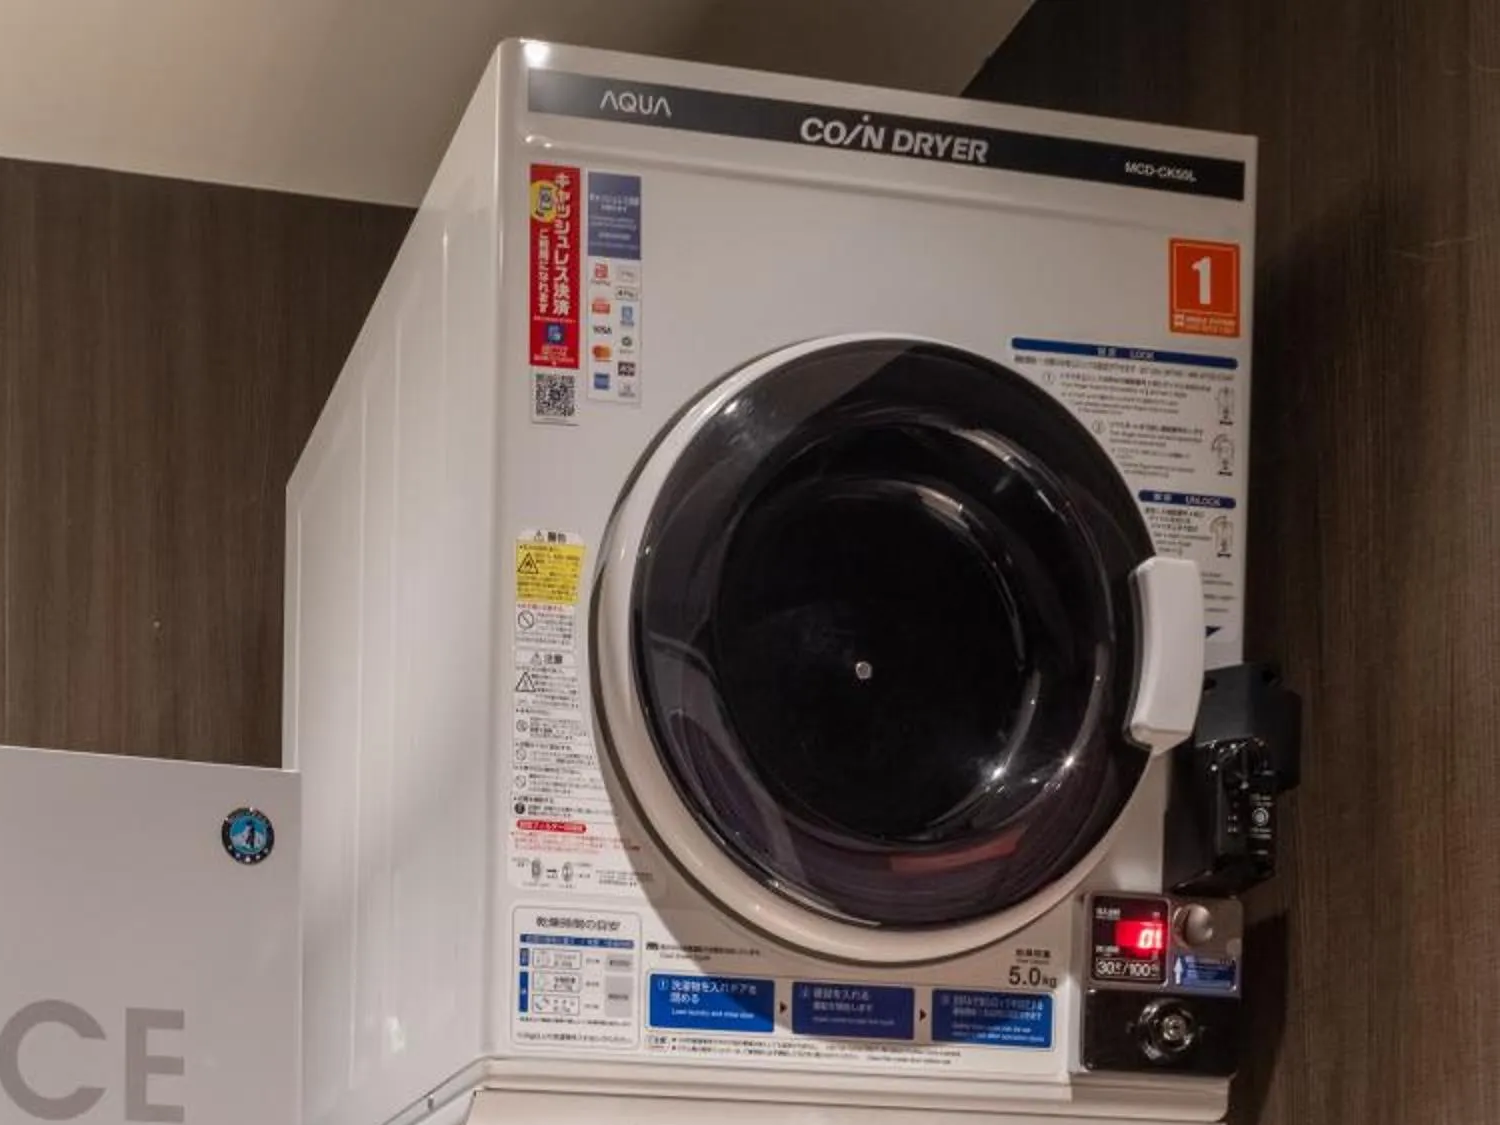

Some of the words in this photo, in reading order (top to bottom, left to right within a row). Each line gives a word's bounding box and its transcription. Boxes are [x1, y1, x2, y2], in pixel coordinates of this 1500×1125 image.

[599, 89, 672, 118] AQUA
[800, 114, 886, 150] COIN
[891, 128, 989, 164] DRYER
[1191, 255, 1212, 306] 1
